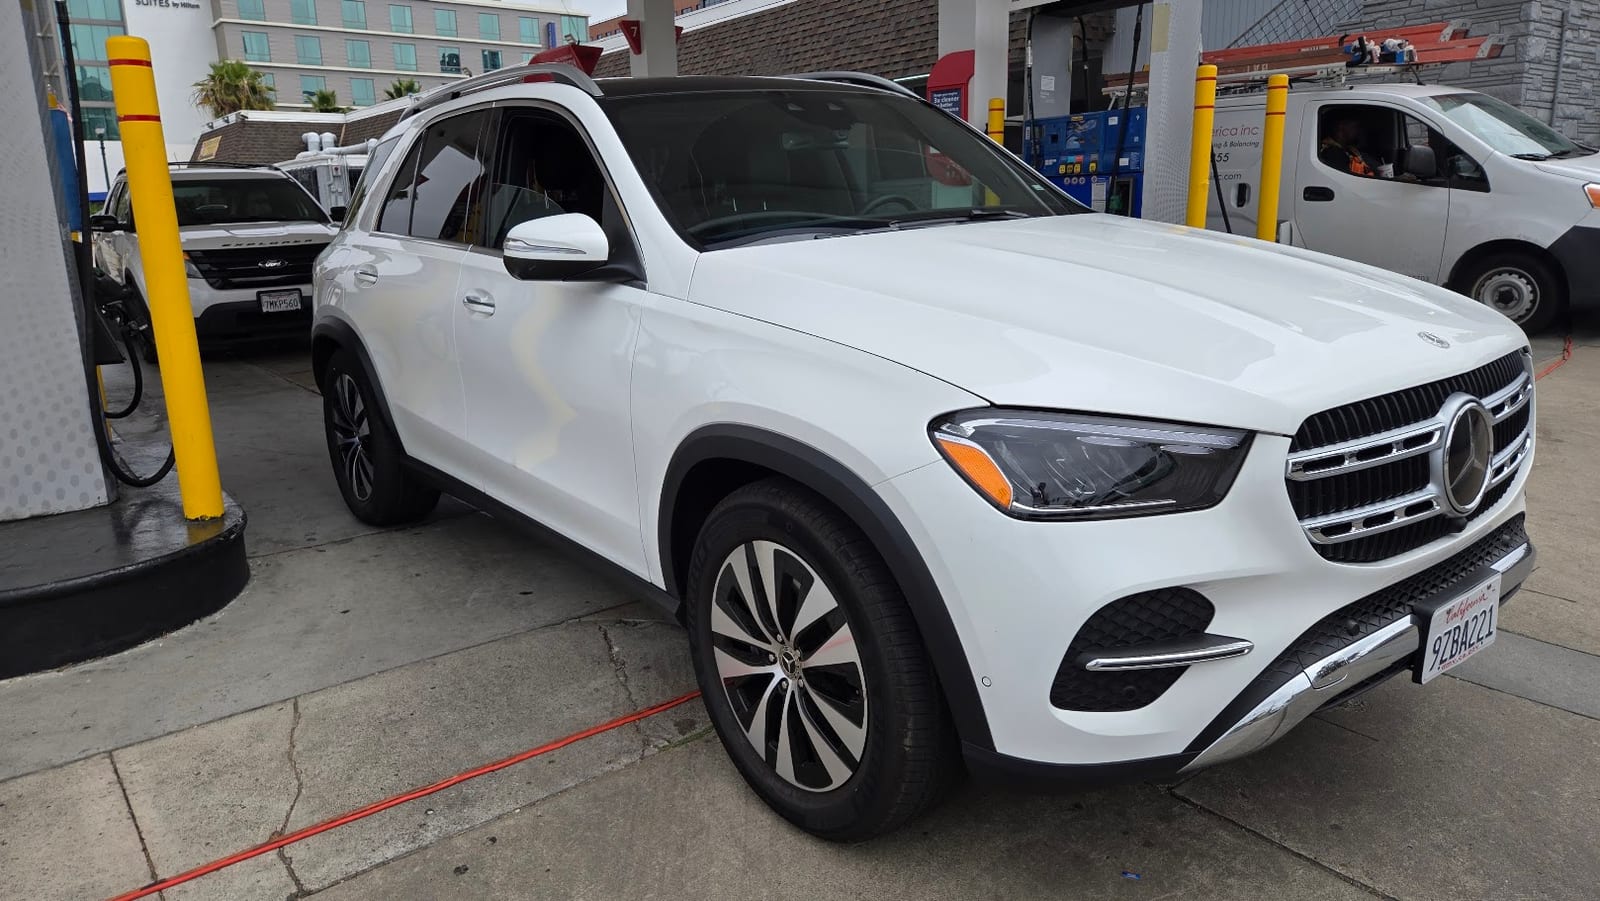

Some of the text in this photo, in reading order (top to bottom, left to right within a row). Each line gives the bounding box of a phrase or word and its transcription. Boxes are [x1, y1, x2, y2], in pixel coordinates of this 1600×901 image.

[630, 26, 638, 38] 7
[1212, 124, 1260, 137] erica inc
[1229, 140, 1260, 148] Balancing
[1215, 152, 1230, 163] 55
[221, 239, 313, 248] EXPLORER
[264, 299, 299, 310] 7MKP560
[1445, 590, 1489, 625] California
[1429, 604, 1495, 672] 9ZBA221
